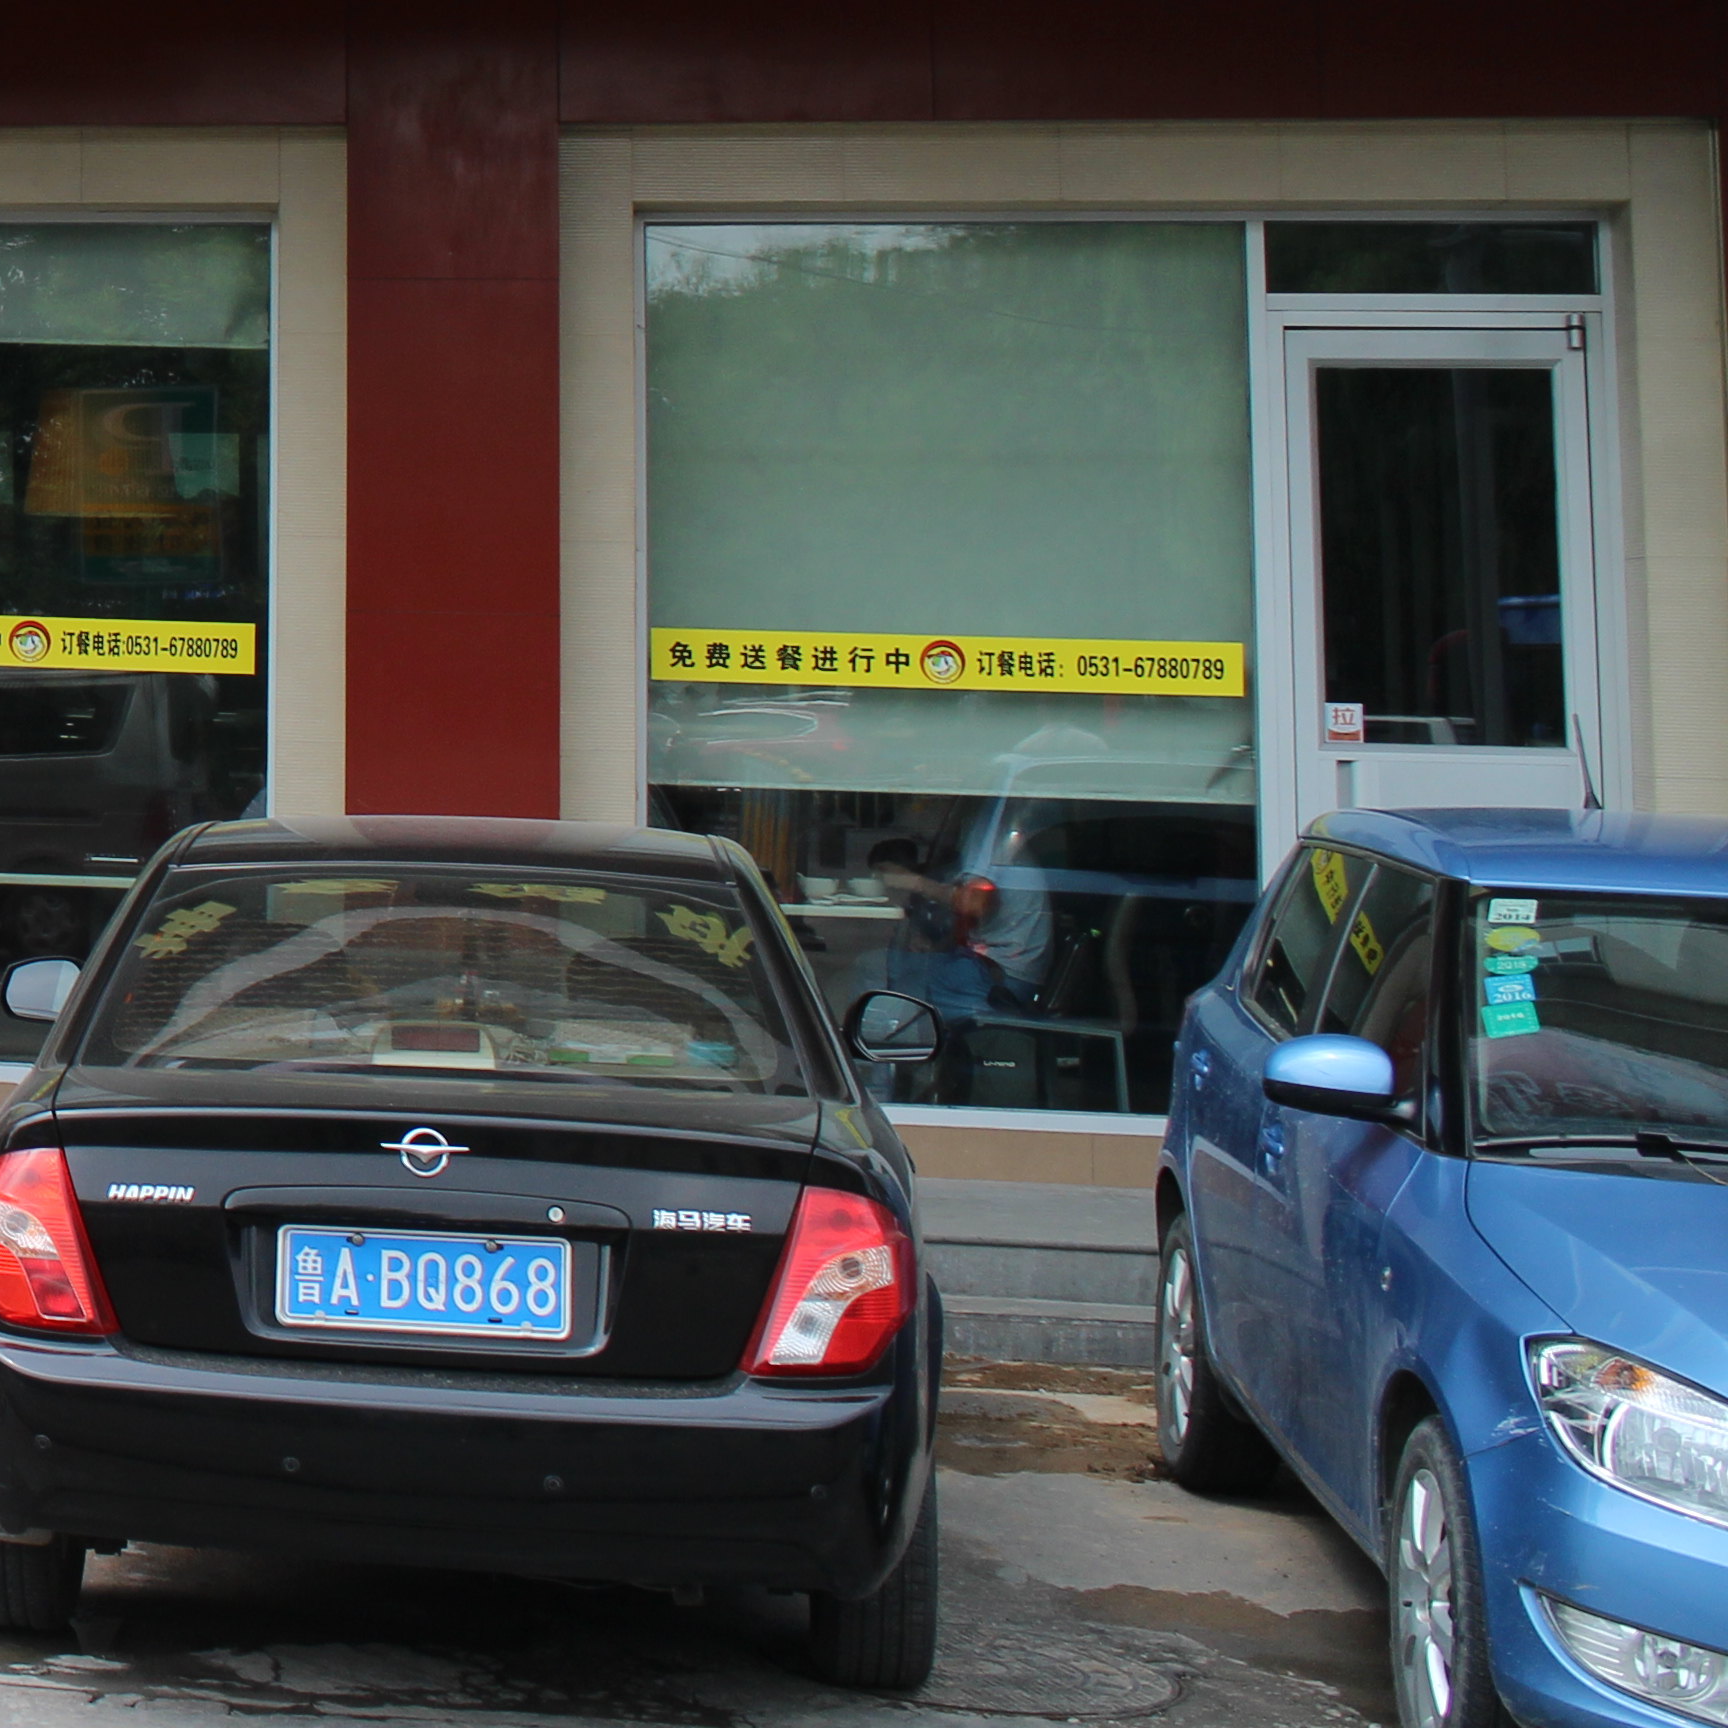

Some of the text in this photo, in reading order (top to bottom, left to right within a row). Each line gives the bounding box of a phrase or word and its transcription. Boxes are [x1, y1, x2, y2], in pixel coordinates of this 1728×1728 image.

[668, 640, 911, 674] 免费送餐进行中
[1332, 707, 1355, 725] 拉
[1494, 992, 1532, 1003] 2016
[107, 1184, 195, 1202] HAPPIN
[652, 1209, 752, 1232] 海马汽车
